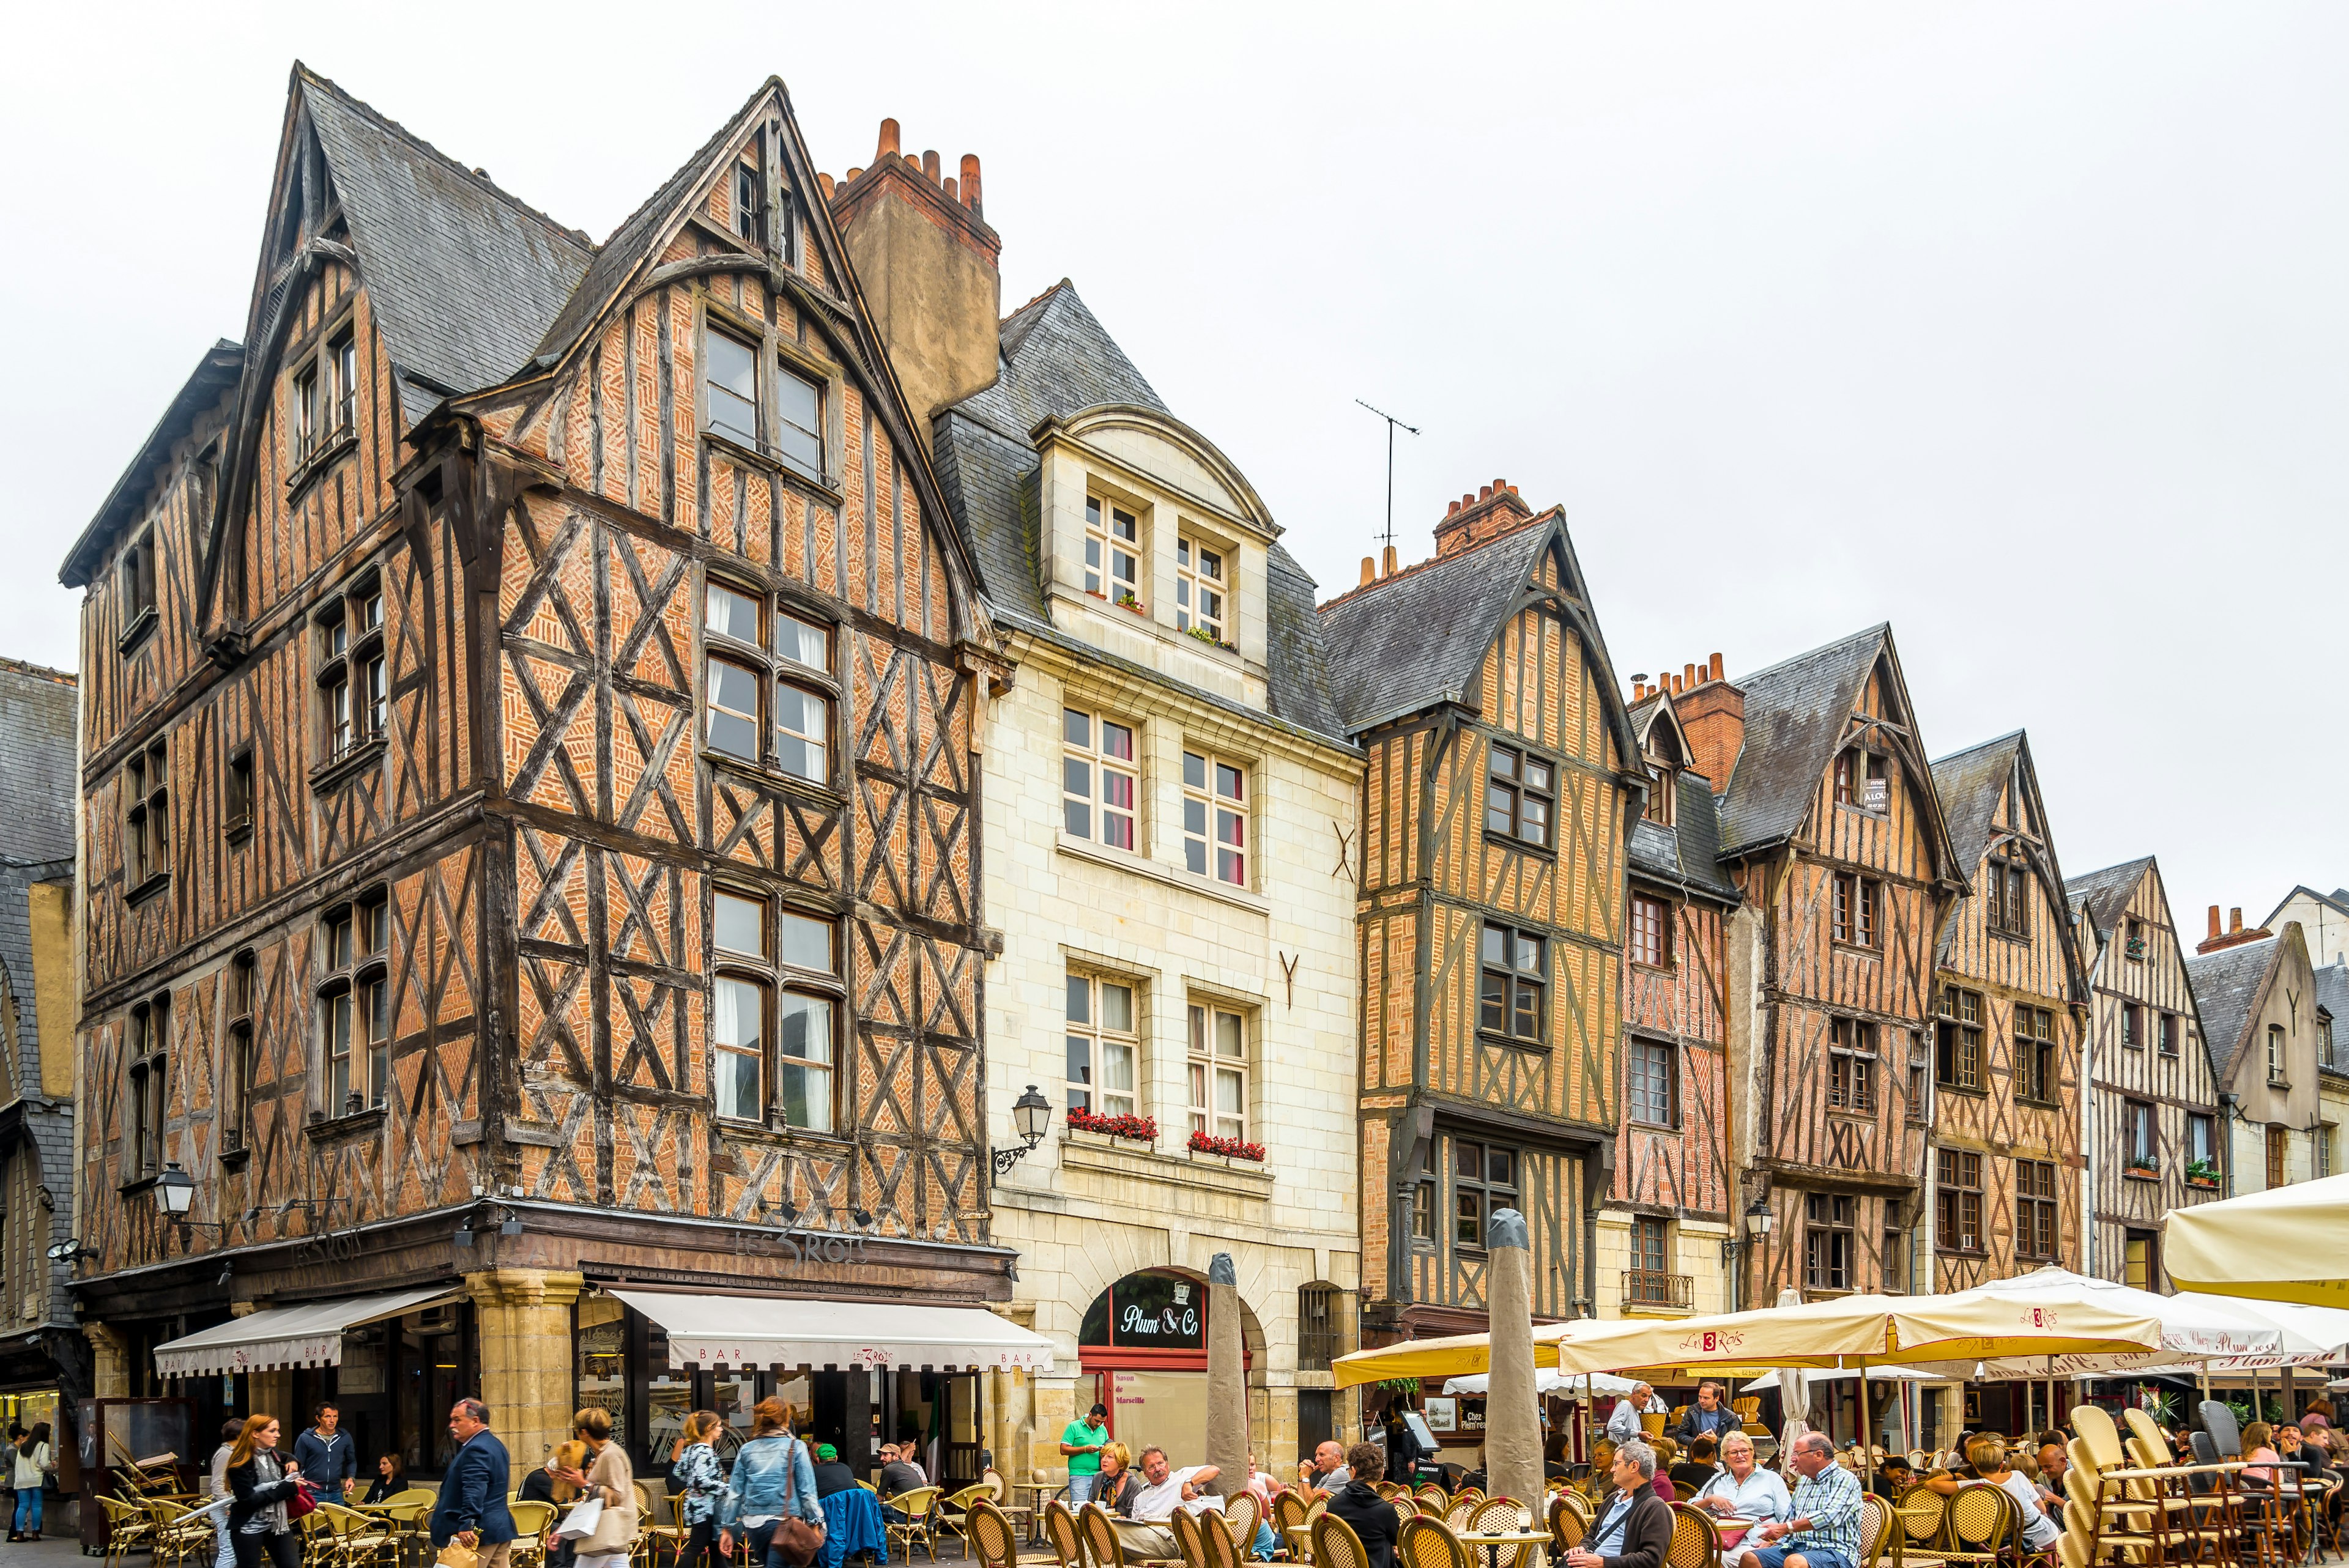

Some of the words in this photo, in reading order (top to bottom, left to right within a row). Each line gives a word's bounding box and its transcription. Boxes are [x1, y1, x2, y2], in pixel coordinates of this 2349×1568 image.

[735, 1231, 773, 1258] LES
[776, 1211, 803, 1275] 3
[805, 1232, 869, 1265] ROIS
[1162, 1307, 1181, 1336] &
[1182, 1307, 1198, 1336] Co
[2020, 1307, 2034, 1325] Les
[2035, 1310, 2041, 1326] 3
[2042, 1307, 2057, 1332] Rois
[1679, 1333, 1703, 1350] Les
[1704, 1334, 1715, 1350] 3
[1716, 1330, 1745, 1354] Rois
[2189, 1329, 2210, 1352] Chez
[306, 1345, 327, 1358] BAR
[700, 1348, 741, 1359] BAR
[853, 1352, 864, 1361] LES
[862, 1348, 873, 1369] 3
[874, 1351, 894, 1363] ROIS
[1001, 1353, 1031, 1363] BAR
[1461, 1420, 1486, 1430] Plum'rea
[1468, 1411, 1482, 1421] Chez
